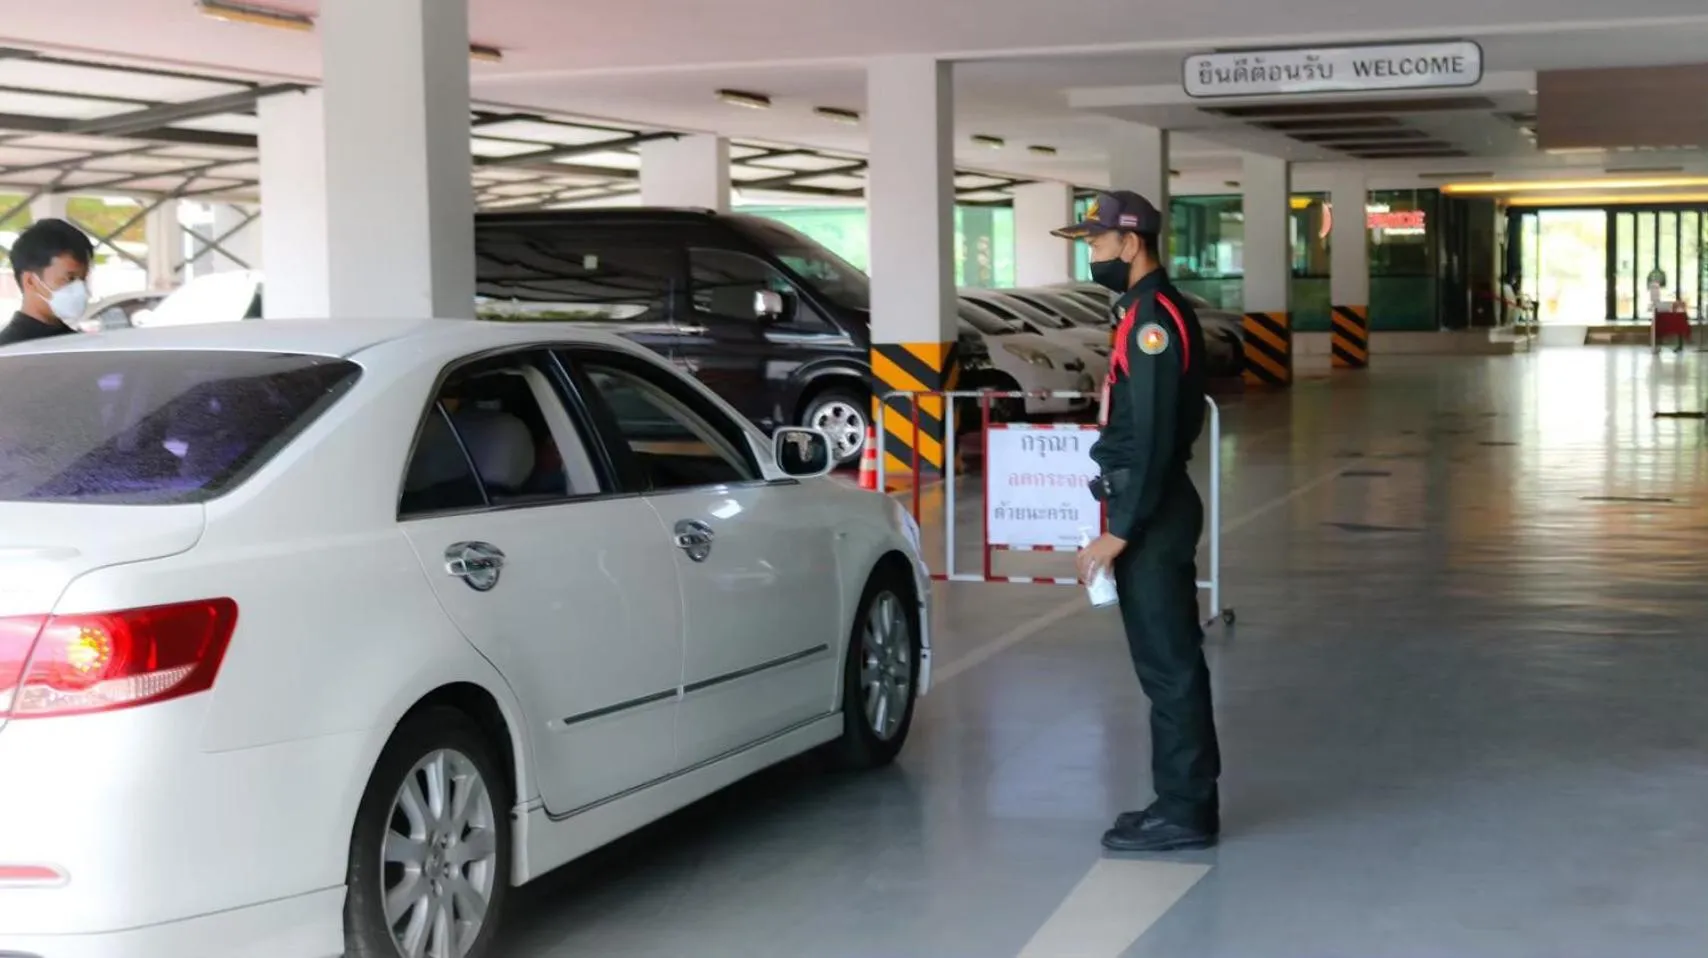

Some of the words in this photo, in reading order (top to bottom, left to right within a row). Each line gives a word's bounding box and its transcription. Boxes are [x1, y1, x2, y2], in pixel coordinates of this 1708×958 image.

[1198, 54, 1334, 85] ยินดีต้อนรับ
[1352, 56, 1465, 78] WELCOME
[1021, 434, 1079, 458] กรุณา
[994, 501, 1079, 521] ด้วยนะครับ
